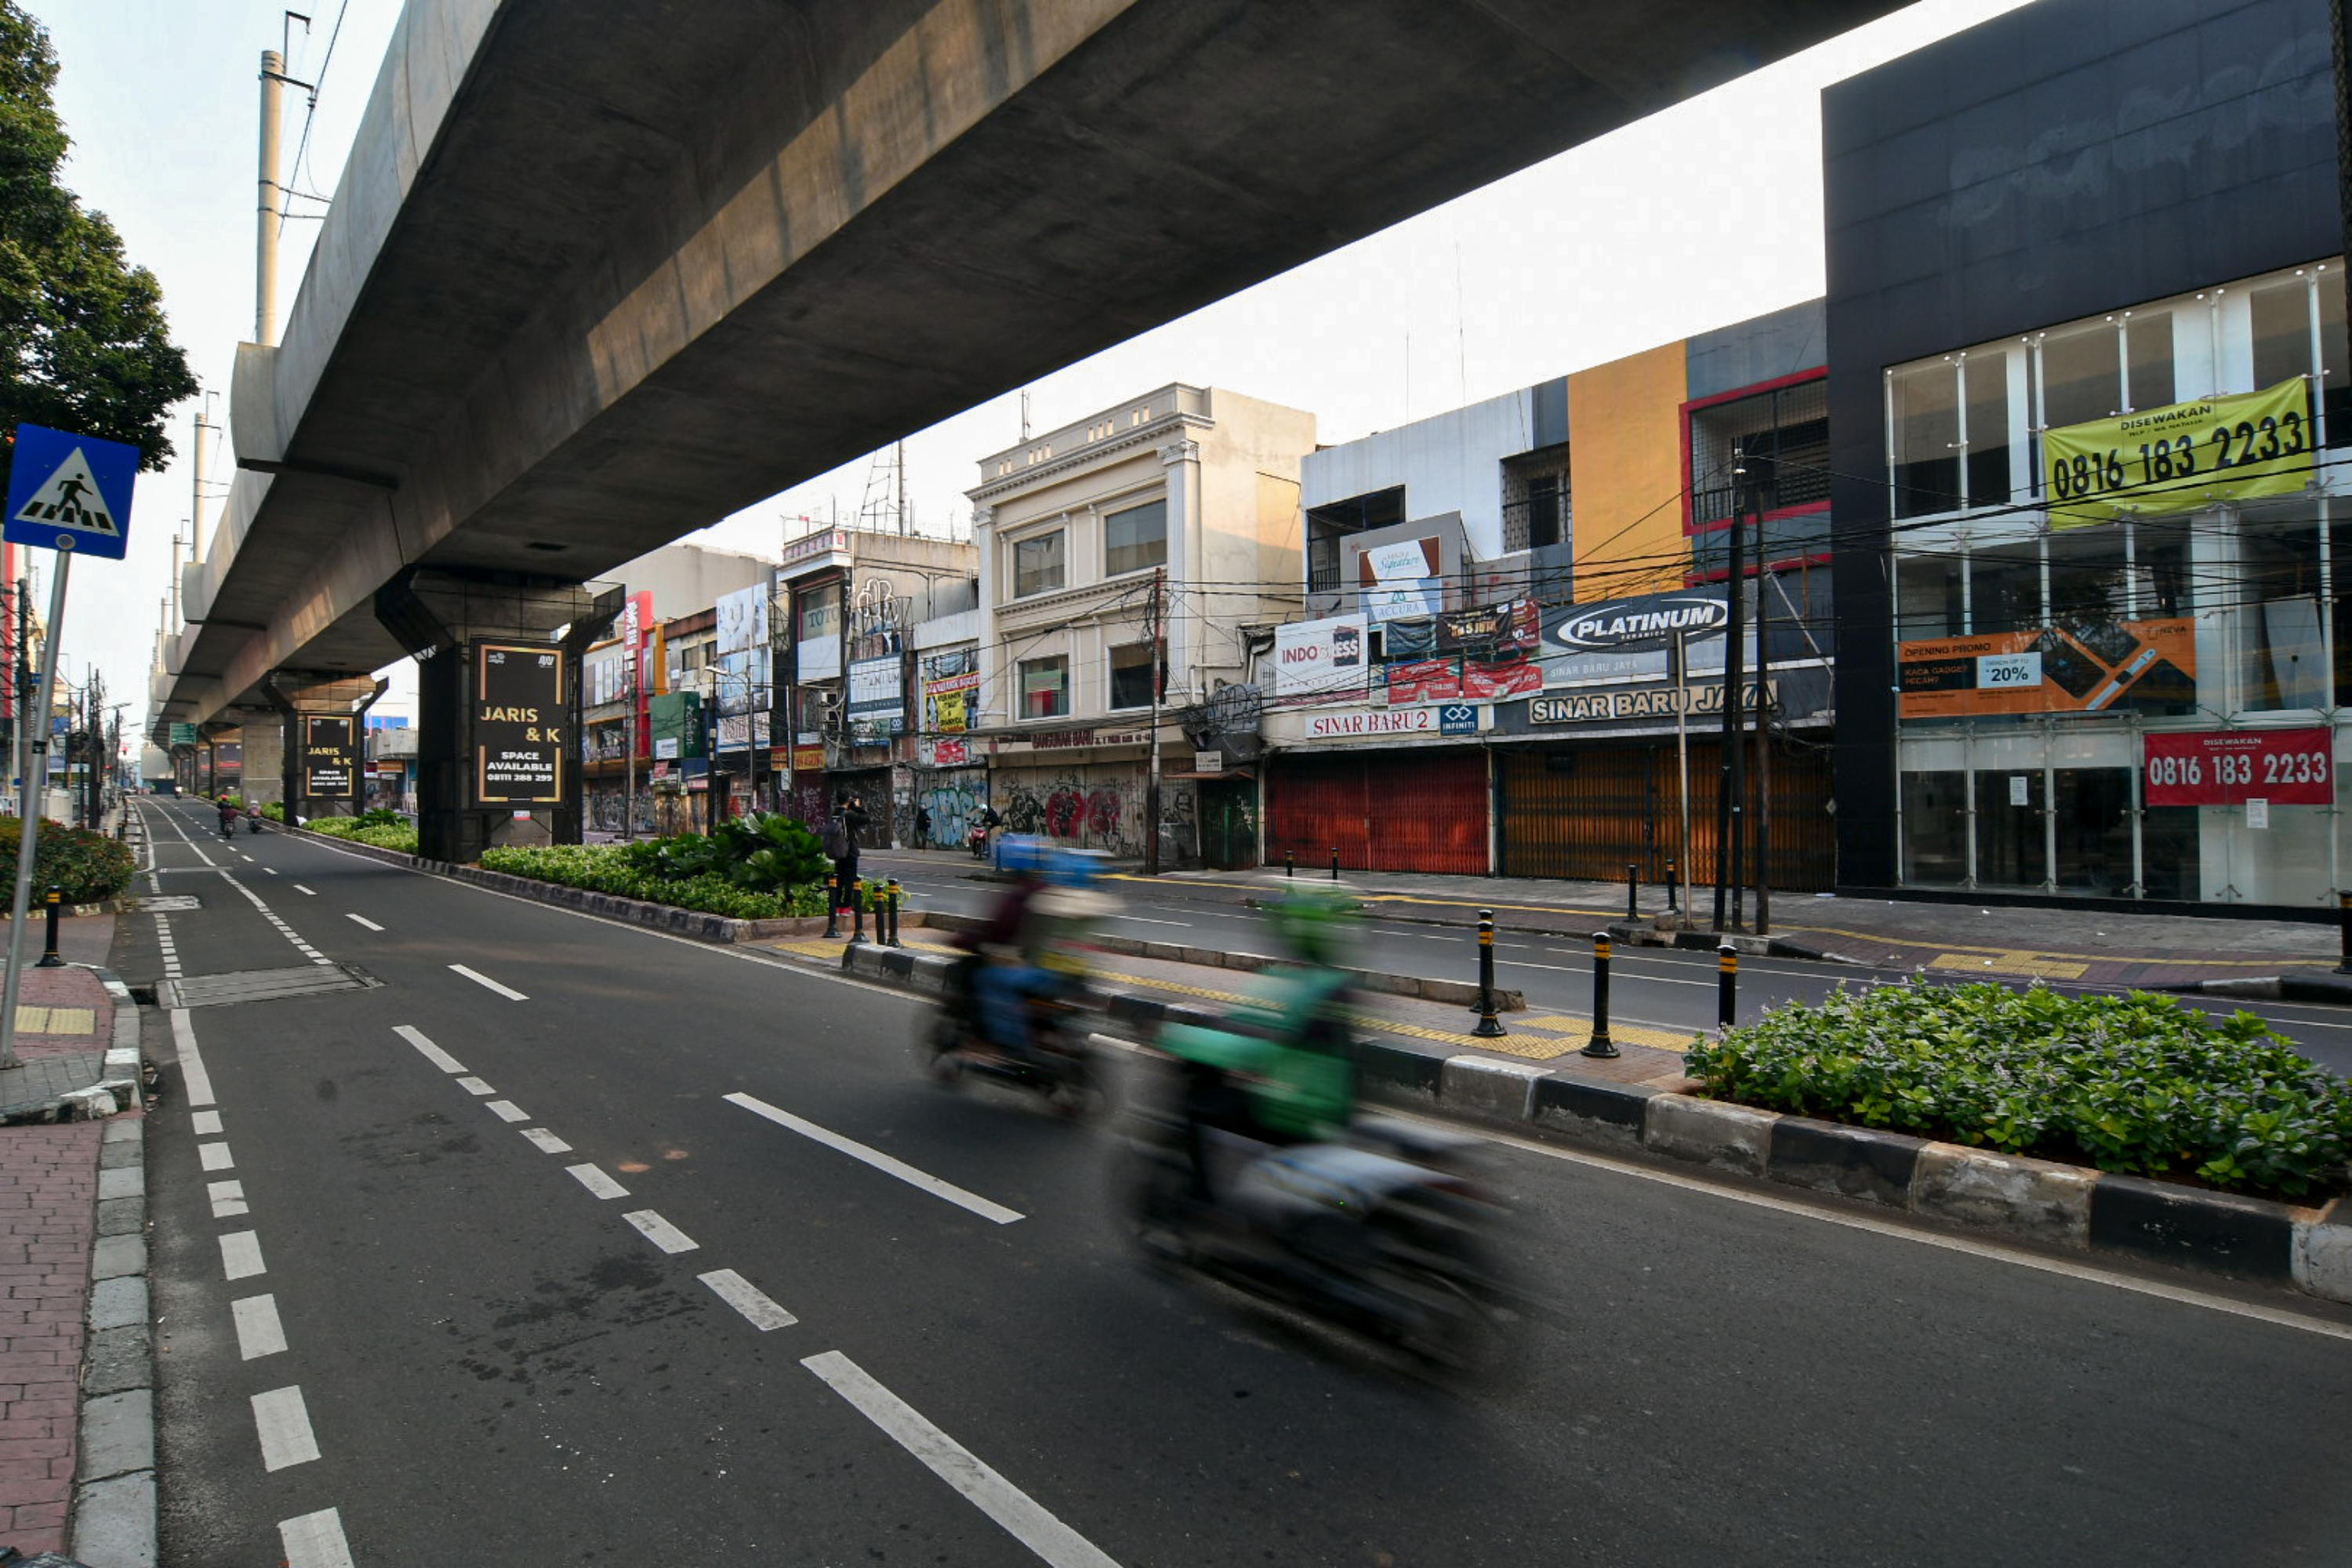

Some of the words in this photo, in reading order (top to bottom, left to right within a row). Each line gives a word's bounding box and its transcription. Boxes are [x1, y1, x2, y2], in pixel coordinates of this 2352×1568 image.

[2121, 405, 2210, 430] DISEWAKAN
[2054, 448, 2123, 499] 0816
[2139, 435, 2194, 484] 183
[2211, 411, 2303, 470] 2233
[1379, 603, 1420, 616] ACCURA
[1577, 605, 1715, 637] PLATINUM
[1904, 645, 1949, 656] OPENING
[1952, 643, 1991, 652] PROMO
[1550, 666, 1579, 677] SINAR
[1583, 663, 1608, 674] BARU
[1614, 661, 1637, 672] JAYA
[1991, 666, 2029, 681] 20%
[1533, 695, 1610, 722] SINAR
[1615, 690, 1690, 717] BARU
[480, 707, 539, 722] JARIS
[1313, 715, 1363, 735] SINAR
[1368, 712, 1413, 731] BARU
[1417, 710, 1428, 728] 2
[1443, 721, 1475, 730] INFINITI
[524, 728, 541, 742] &
[546, 728, 561, 742] K
[501, 752, 540, 760] SPACE
[487, 761, 552, 771] AVAILABLE
[2150, 757, 2201, 786] 0816
[2212, 755, 2252, 784] 183
[2263, 752, 2326, 784] 2233
[487, 773, 511, 782] 08111
[535, 774, 553, 782] 299
